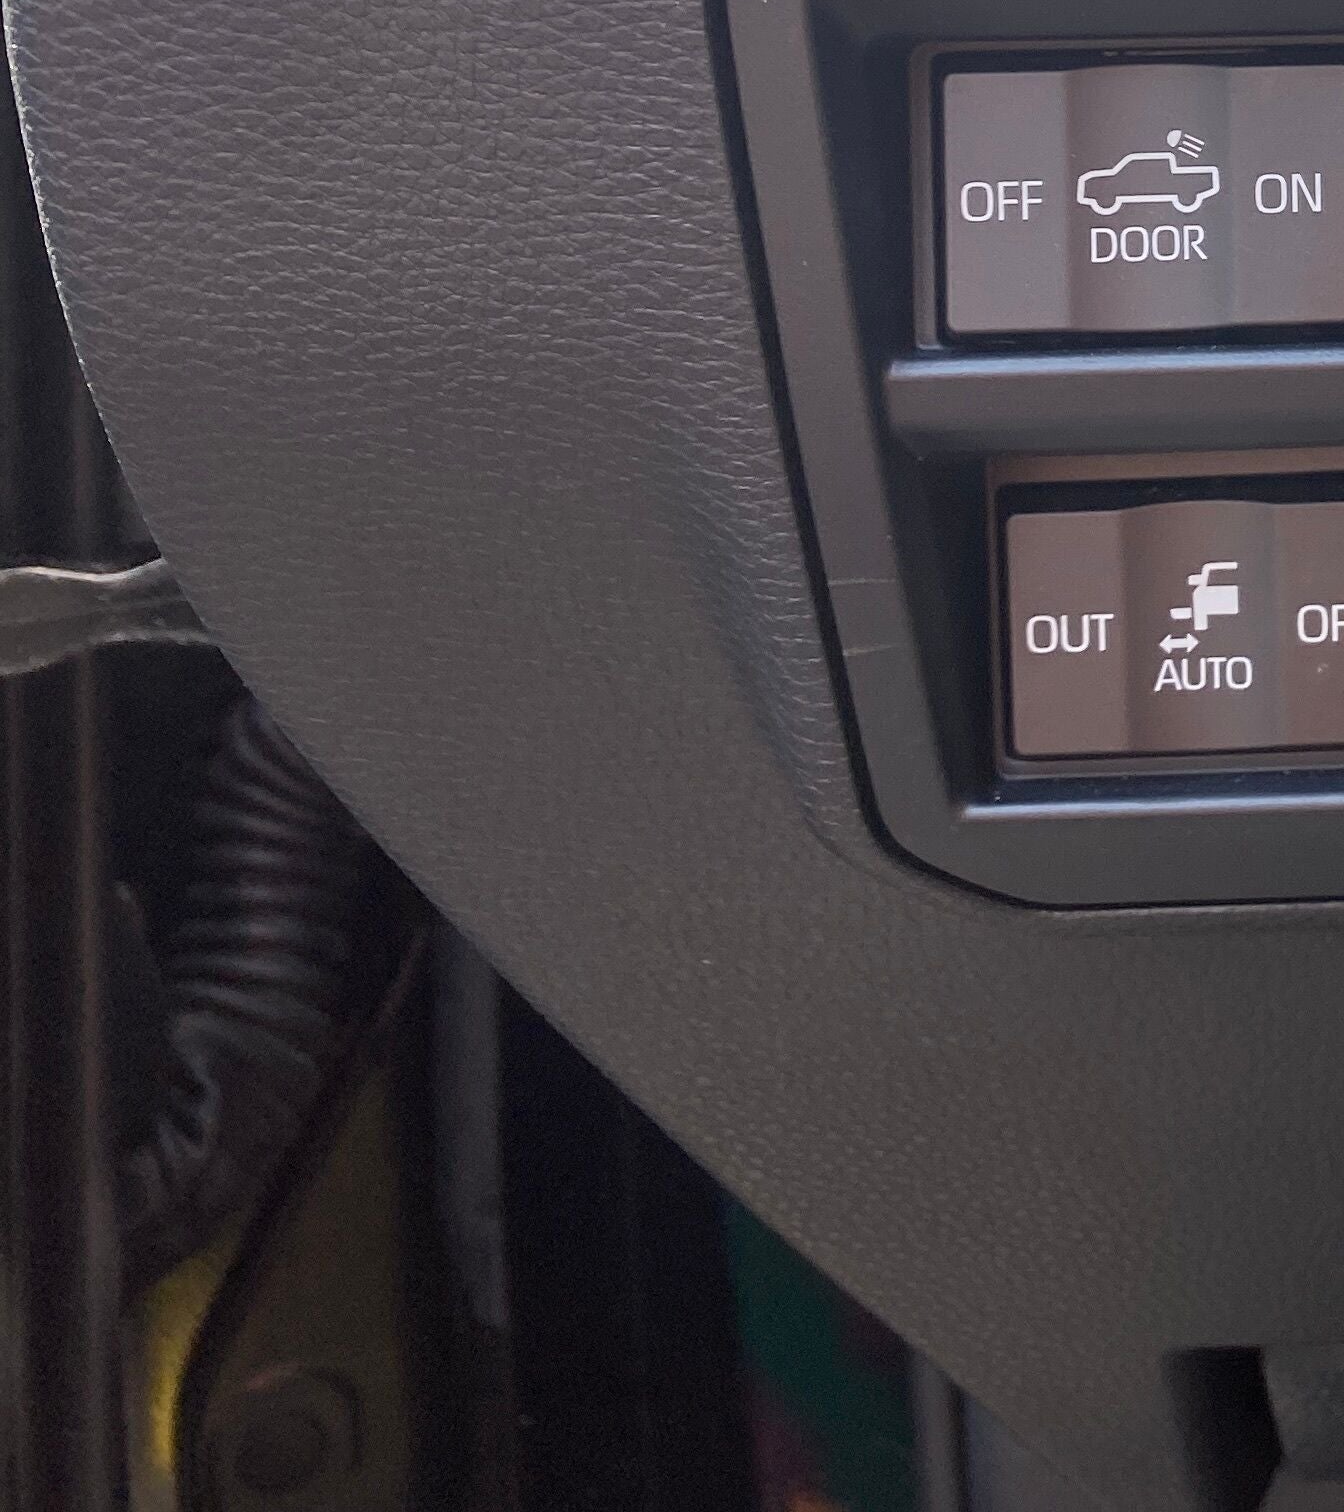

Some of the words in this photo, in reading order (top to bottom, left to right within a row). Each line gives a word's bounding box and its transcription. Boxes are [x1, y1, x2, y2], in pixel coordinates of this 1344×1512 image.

[960, 180, 1045, 222] OFF
[1254, 172, 1322, 214] ON
[1090, 224, 1208, 263] DOOR
[1025, 613, 1114, 655] OUT
[1153, 656, 1253, 693] AUTO
